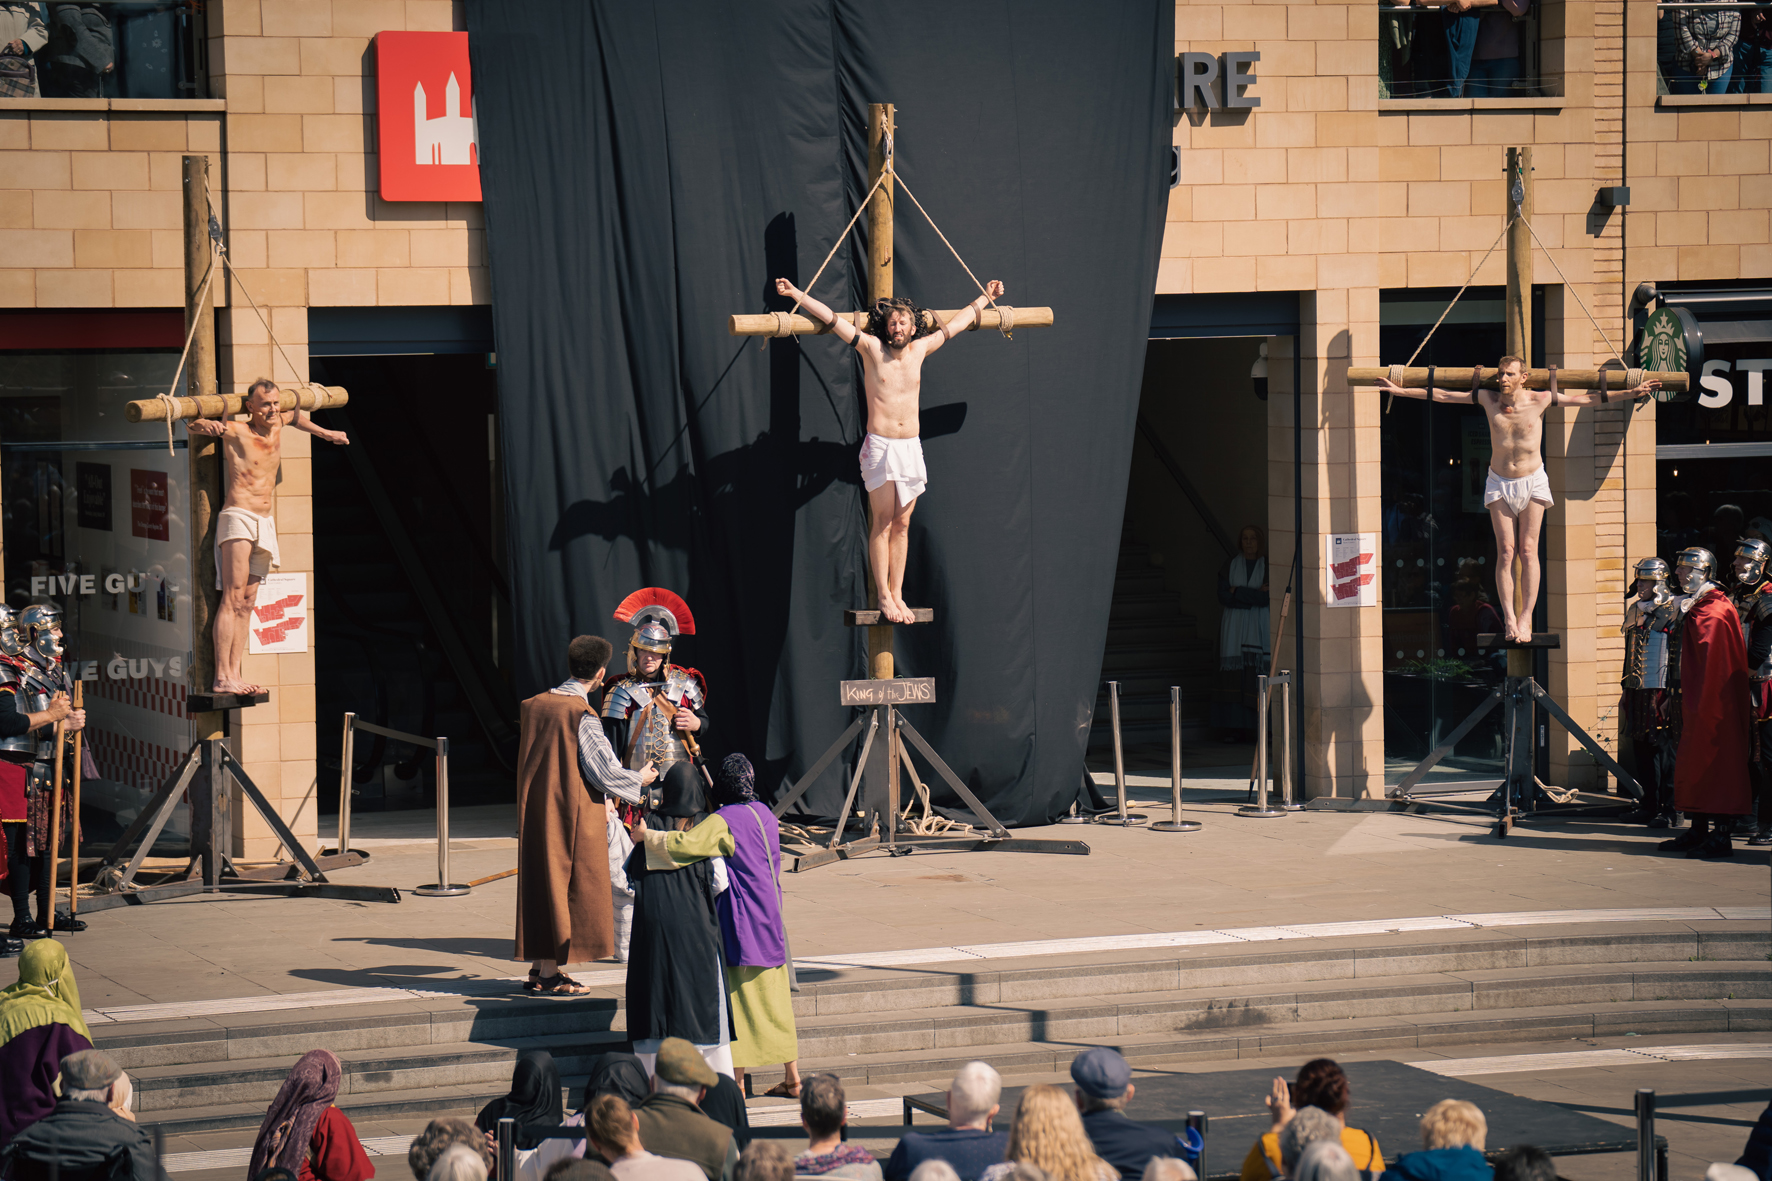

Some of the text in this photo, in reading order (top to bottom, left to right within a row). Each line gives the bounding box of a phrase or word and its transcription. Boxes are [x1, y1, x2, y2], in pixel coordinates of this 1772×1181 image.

[1175, 51, 1261, 108] RE
[1697, 358, 1772, 409] ST
[31, 573, 180, 597] FIVE GU
[107, 657, 182, 680] GUYS
[846, 682, 931, 703] KING of the JEWS
